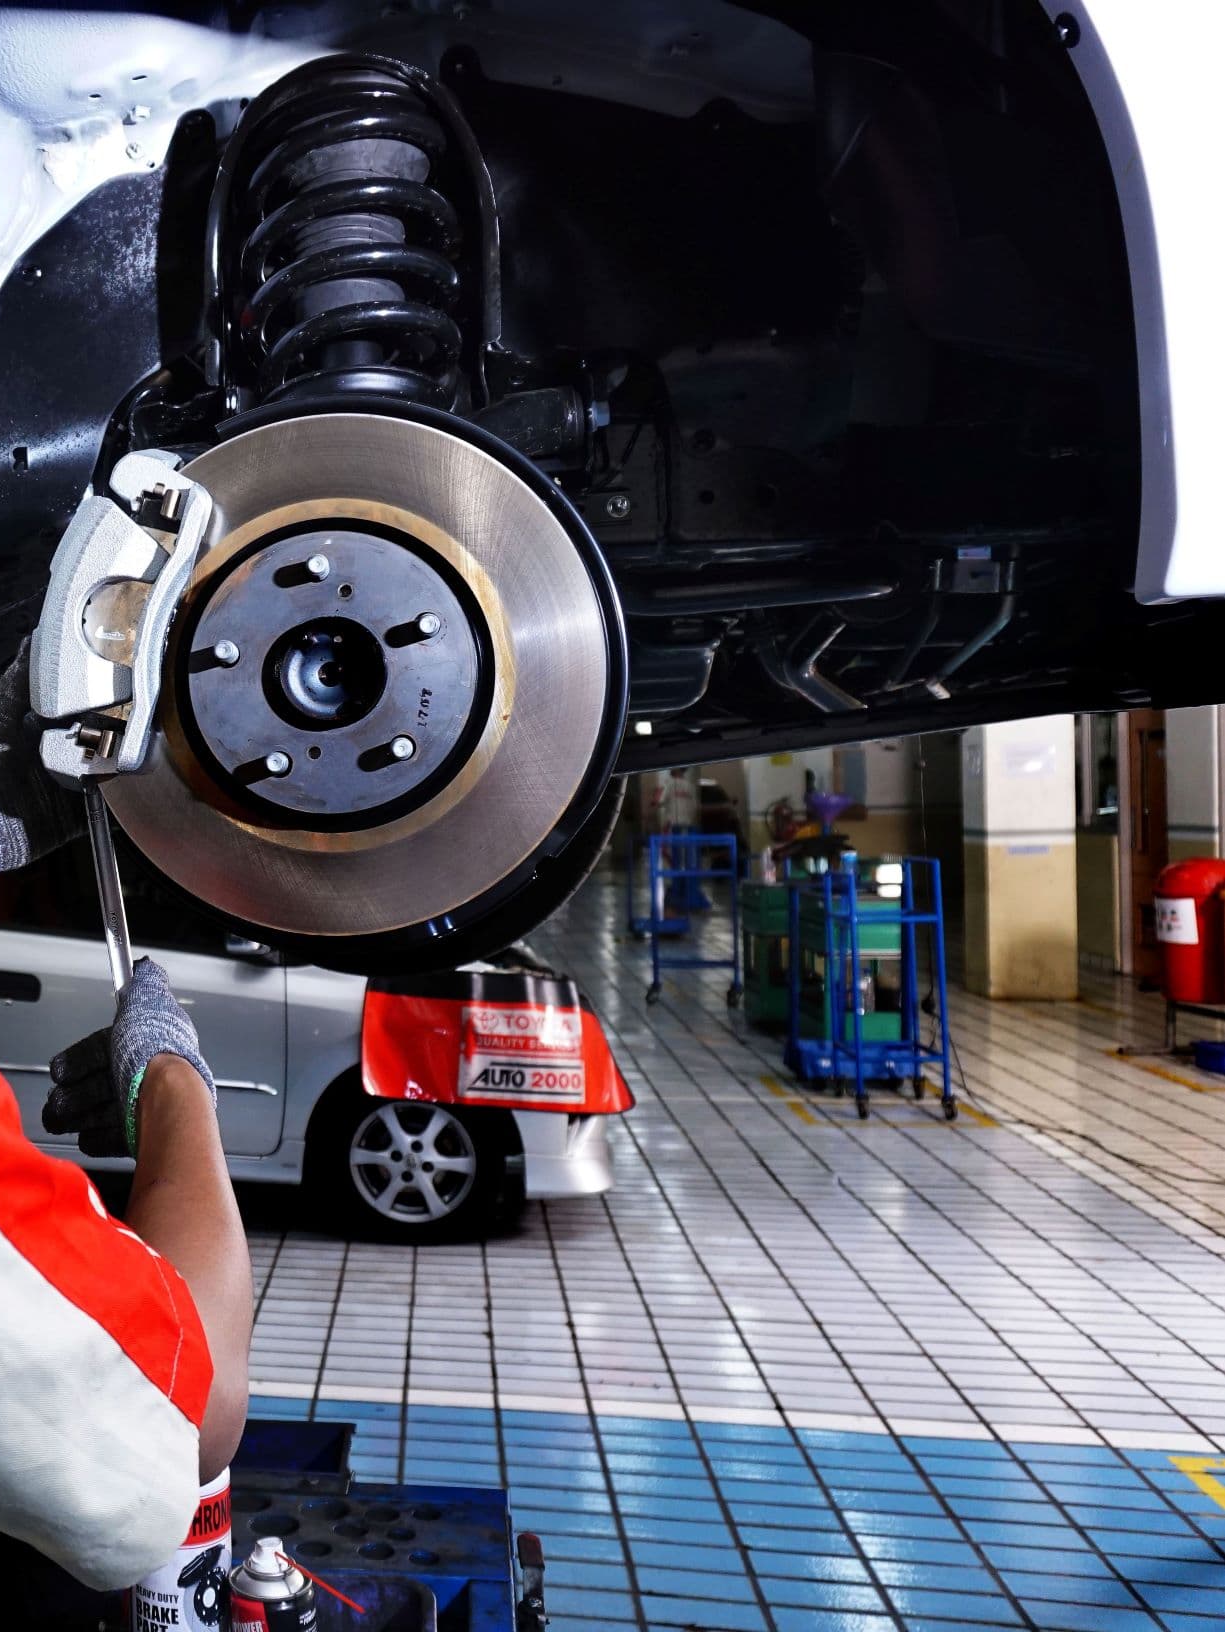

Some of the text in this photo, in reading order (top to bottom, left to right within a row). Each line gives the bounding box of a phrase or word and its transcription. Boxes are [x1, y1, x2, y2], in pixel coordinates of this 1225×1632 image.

[504, 1014, 573, 1032] TOYA
[471, 1067, 582, 1090] AUTO 2000
[157, 1591, 179, 1604] DUTY
[135, 1596, 179, 1625] BRAKE
